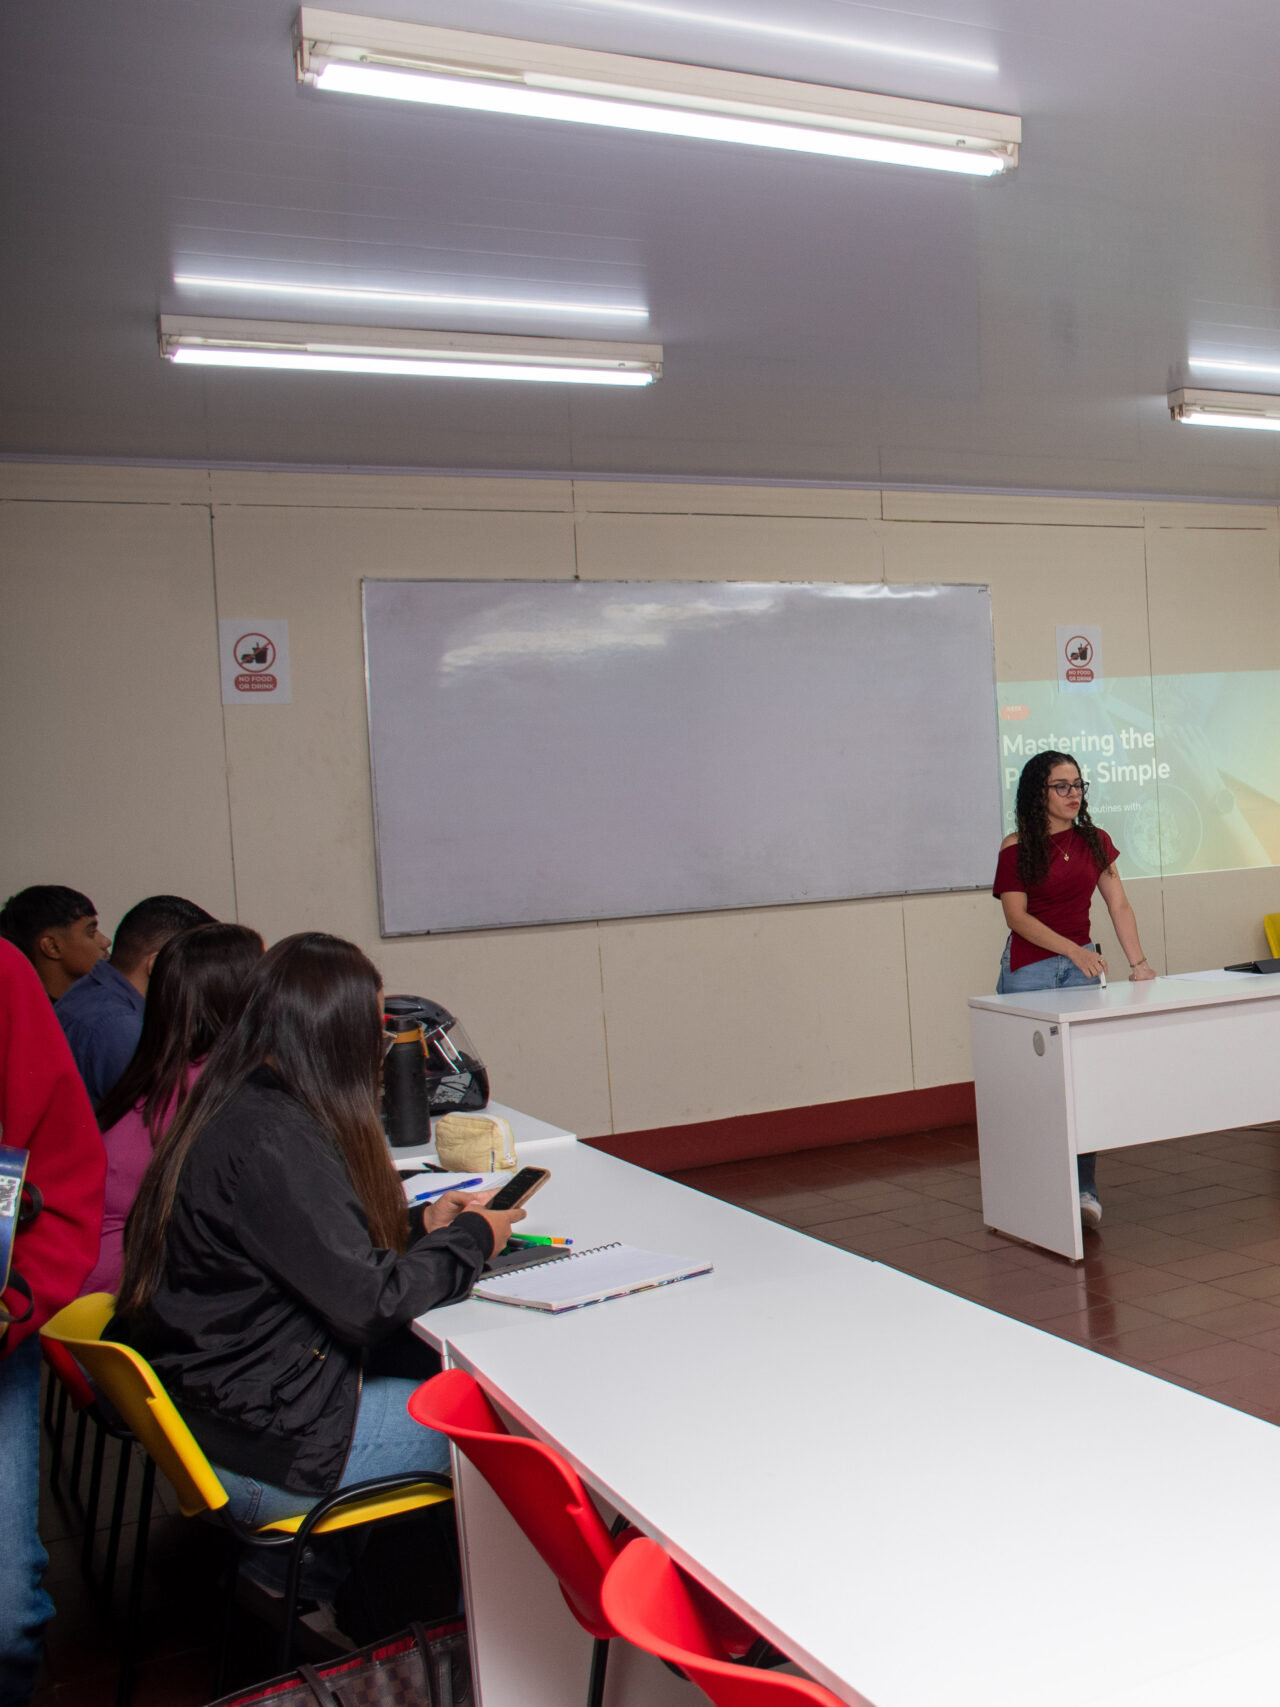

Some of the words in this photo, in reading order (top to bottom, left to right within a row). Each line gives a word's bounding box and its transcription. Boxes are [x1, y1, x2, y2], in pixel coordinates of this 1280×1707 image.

[1002, 730, 1114, 757] Mastering
[1120, 727, 1155, 750] the
[1097, 758, 1171, 787] Simple
